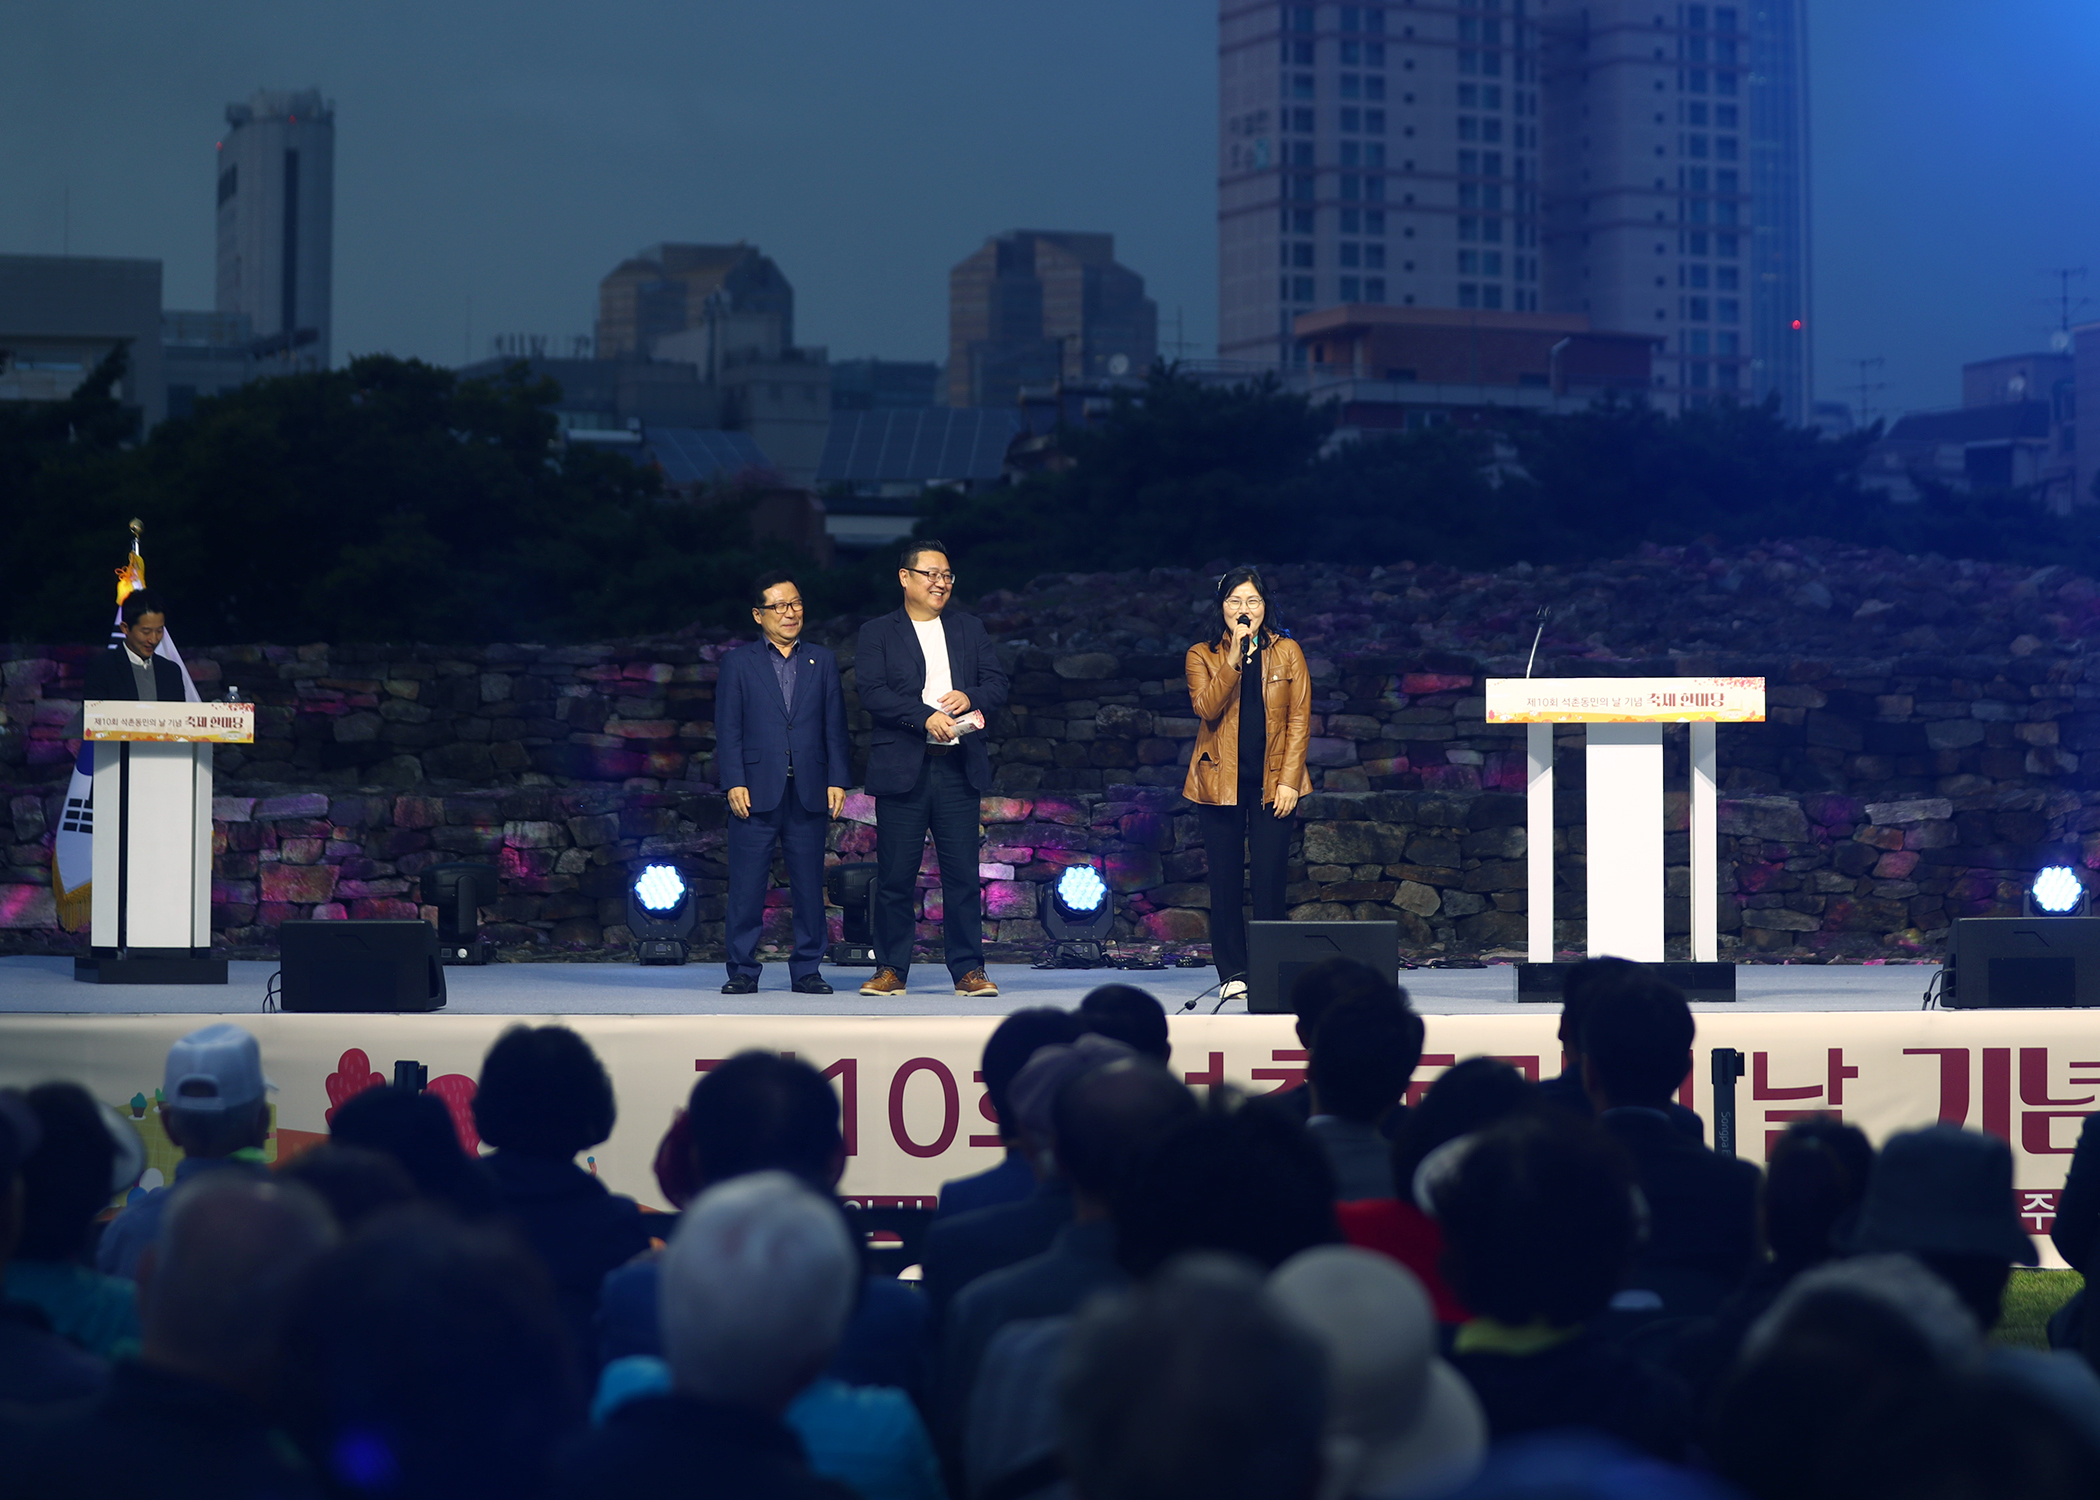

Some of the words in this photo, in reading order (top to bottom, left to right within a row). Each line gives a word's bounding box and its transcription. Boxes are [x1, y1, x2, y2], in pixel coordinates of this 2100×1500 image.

[1526, 697, 1558, 708] 제10회
[1562, 697, 1609, 708] 석촌동민의
[1612, 697, 1621, 708] 날
[1625, 697, 1643, 708] 기념
[1647, 692, 1676, 708] 축제
[1680, 692, 1724, 708] 한마당
[94, 717, 119, 727] 제10회
[121, 717, 157, 728] 석촌동민의
[158, 718, 166, 728] 날
[168, 718, 182, 728] 기념
[185, 715, 207, 728] 축제
[210, 716, 243, 729] 한마당
[1718, 1111, 1731, 1148] Songpa
